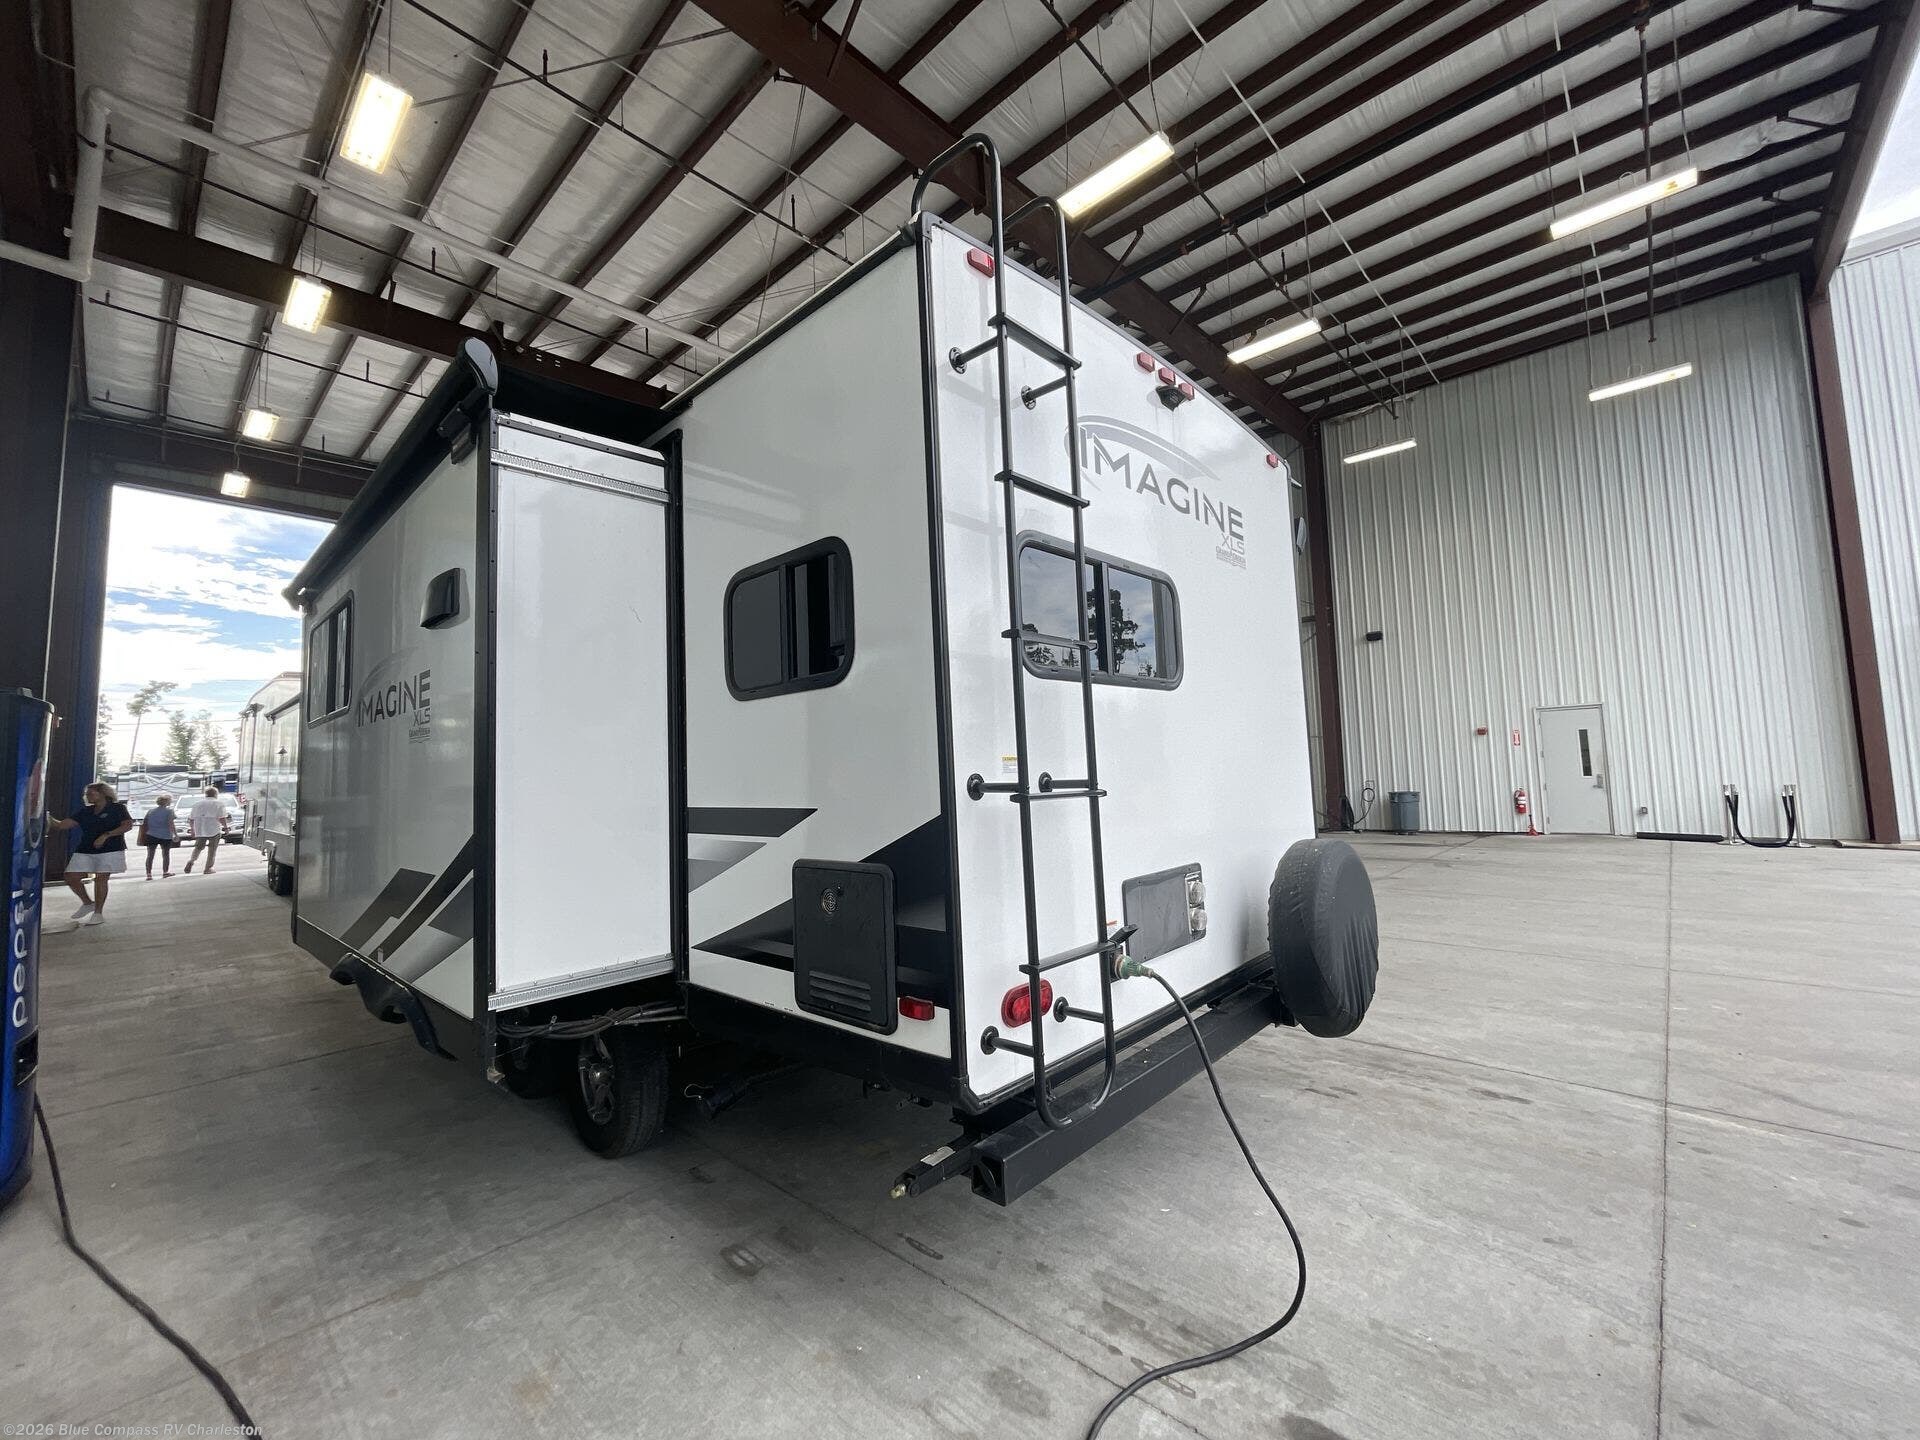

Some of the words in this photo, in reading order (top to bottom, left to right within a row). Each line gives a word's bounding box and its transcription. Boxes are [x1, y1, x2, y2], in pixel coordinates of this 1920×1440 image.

[1079, 425, 1245, 542] IMAGINE
[1221, 532, 1246, 556] XLS
[357, 669, 431, 728] IMAGINE
[413, 707, 431, 727] XLS
